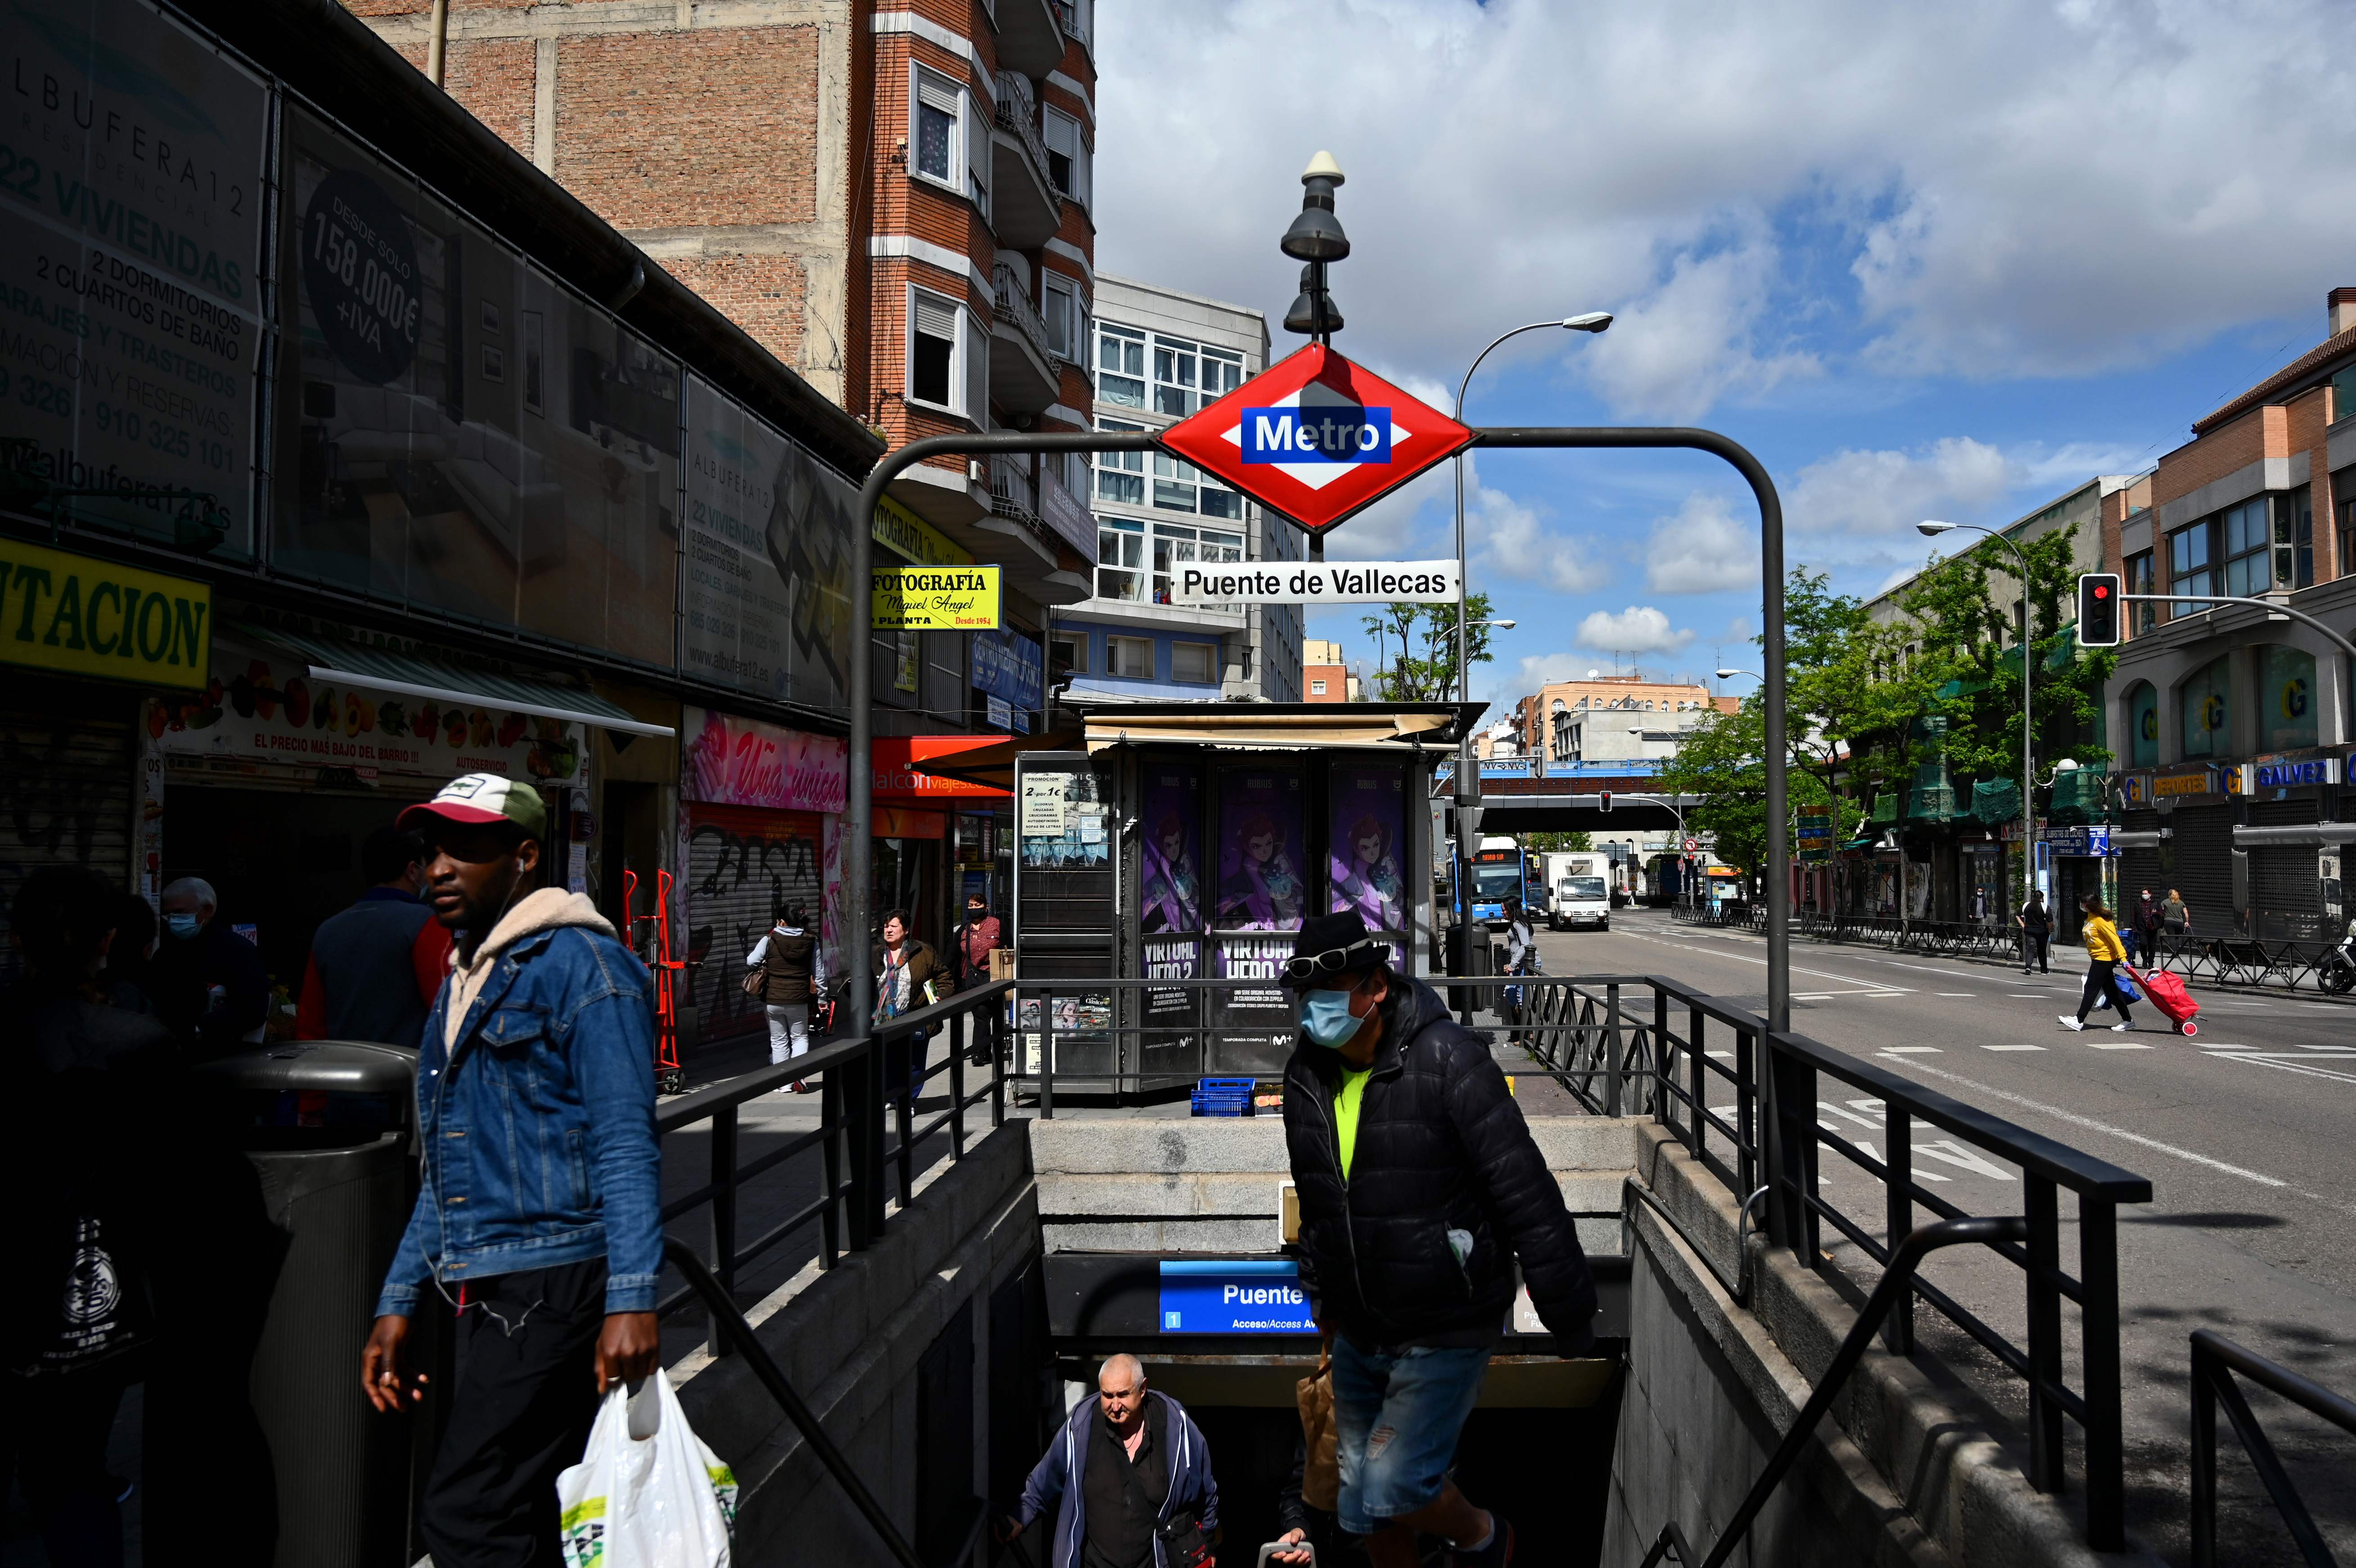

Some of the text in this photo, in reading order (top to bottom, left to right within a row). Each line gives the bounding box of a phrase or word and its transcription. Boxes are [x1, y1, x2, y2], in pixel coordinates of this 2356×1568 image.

[14, 58, 242, 217] LBUFERA12
[23, 113, 210, 226] RESIDENCIAL
[54, 171, 242, 299] VIVIENDAS
[333, 196, 410, 280] DESDE SOLO
[93, 251, 241, 335] 2 DORMITORIOS
[314, 212, 419, 344] 158.000€
[37, 257, 239, 360] 2 CUARTOS DE BAÑO
[0, 283, 236, 398] ARAJES Y TRASTEROS
[336, 301, 382, 353] +IVA
[0, 328, 234, 438] MACIÓN Y RESERVAS:
[20, 374, 234, 473] 326 910 325 101
[1256, 416, 1380, 451] Metro
[694, 453, 770, 509] ALBUFERA12
[693, 500, 763, 552] 22 VIVIENDAS
[872, 504, 923, 561] OTOGRAFÍA
[692, 530, 739, 561] 2 DORMITORIOS
[692, 546, 752, 581] 2 CUARTOS DE BAÑO
[691, 568, 723, 592] LOCALES,
[725, 582, 752, 604] GARAJES
[760, 595, 791, 618] TRASTEROS
[872, 570, 986, 591] FOTOGRAFÍA
[1184, 569, 1446, 595] Puente de Vallecas
[0, 563, 205, 667] TACION
[881, 591, 974, 614] Miguel Ángel
[707, 616, 720, 634] 029
[722, 622, 734, 640] 326
[742, 628, 753, 646] 910
[756, 633, 767, 650] 325
[770, 639, 779, 654] 101
[975, 635, 997, 667] CENTRO
[690, 645, 768, 682] www.albufera12.es
[255, 734, 267, 748] EL
[271, 735, 307, 752] PRECIO
[333, 742, 356, 757] BAJO
[359, 745, 376, 759] DEL
[378, 747, 409, 763] BARRIO
[456, 756, 507, 773] AUTOSERVICIO
[736, 731, 842, 807] Uña única
[1161, 777, 1179, 787] RUBIUS
[1247, 779, 1272, 789] RUBIUS
[1357, 780, 1376, 789] RUBIUS
[2154, 774, 2206, 795] DEPORTES
[2259, 761, 2326, 787] GALVEZ
[1025, 787, 1034, 796] 2
[1048, 787, 1060, 796] 1€
[2046, 829, 2064, 838] SUBASTAS
[2064, 829, 2069, 838] DE
[1145, 941, 1196, 962] VIRTUAL
[1224, 1284, 1303, 1304] Puente
[1232, 1319, 1301, 1329] Acceso/Access
[1304, 1319, 1316, 1328] Av
